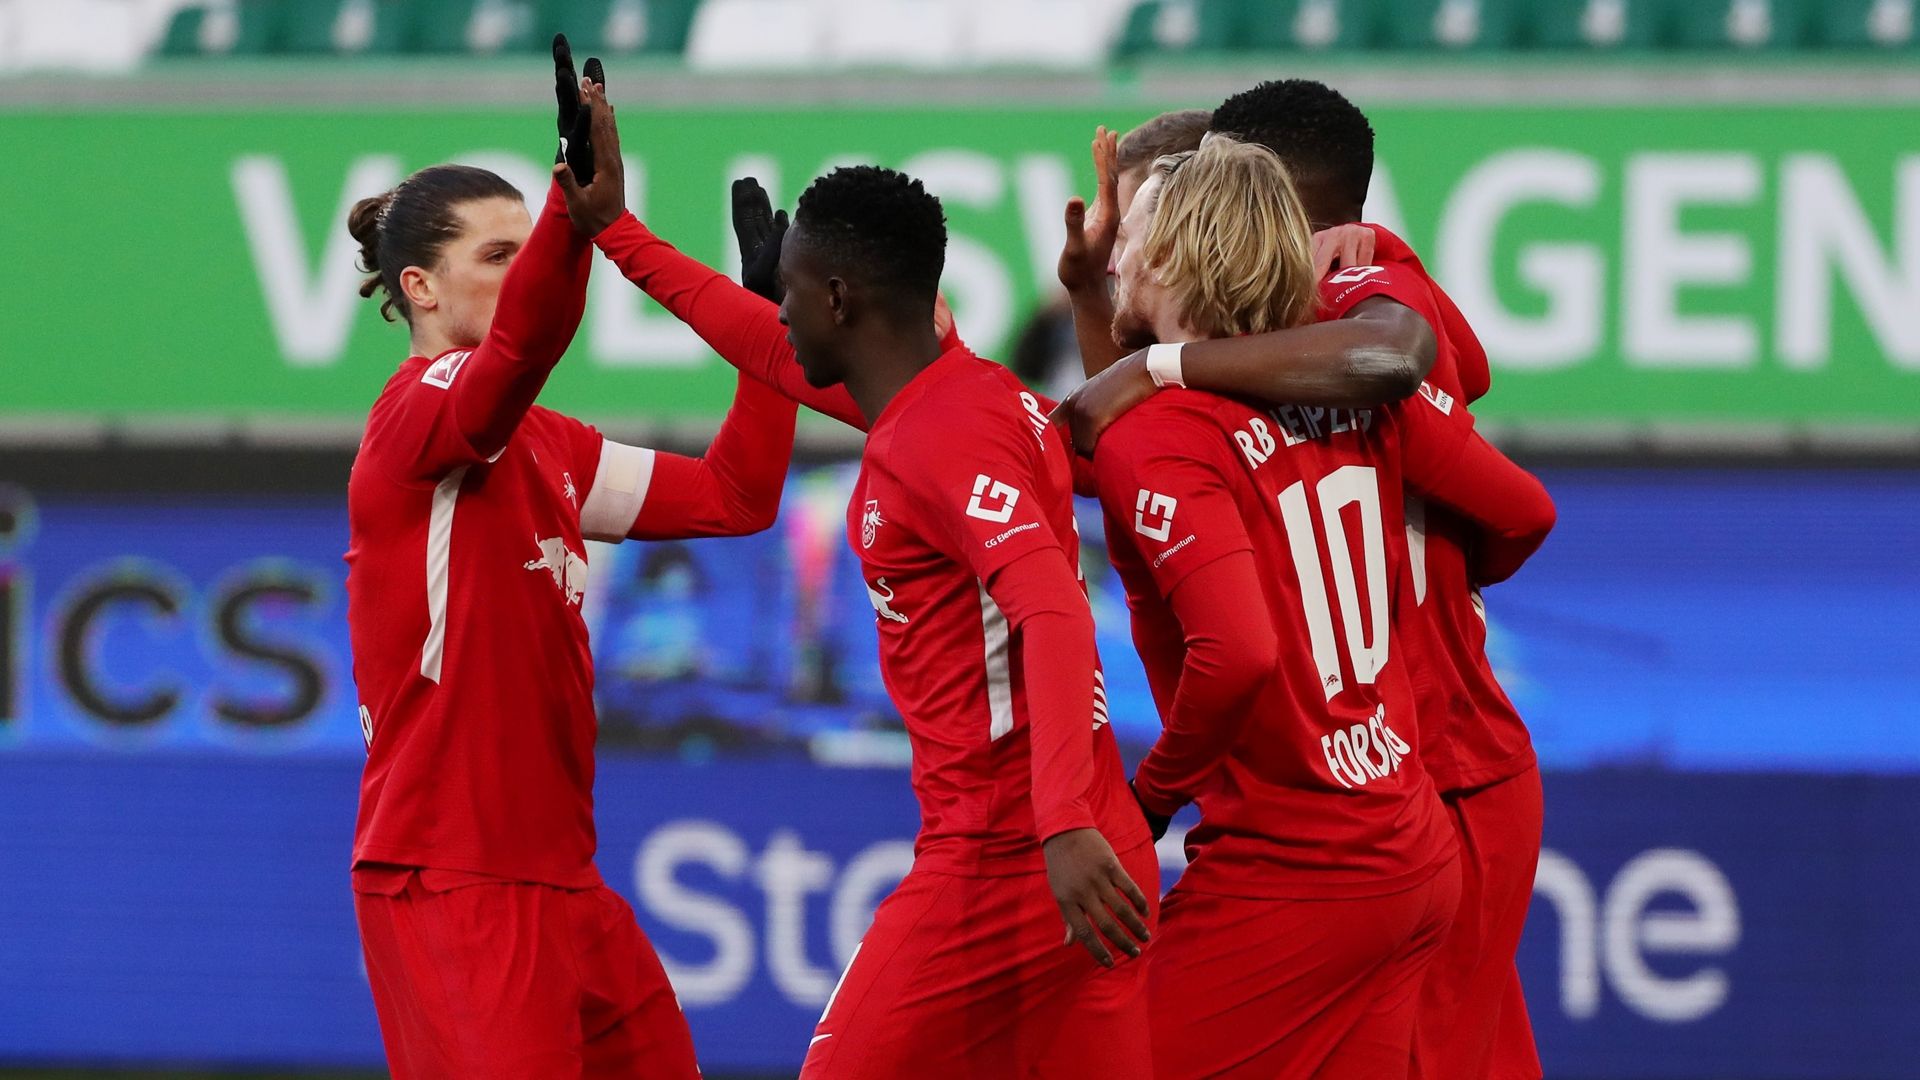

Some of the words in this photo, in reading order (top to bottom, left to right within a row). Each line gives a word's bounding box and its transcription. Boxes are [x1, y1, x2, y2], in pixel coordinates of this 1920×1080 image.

[1234, 417, 1276, 470] RB
[984, 537, 998, 549] CG
[996, 521, 1041, 544] Elementum
[1158, 533, 1197, 563] Elementum
[1277, 465, 1391, 704] 10
